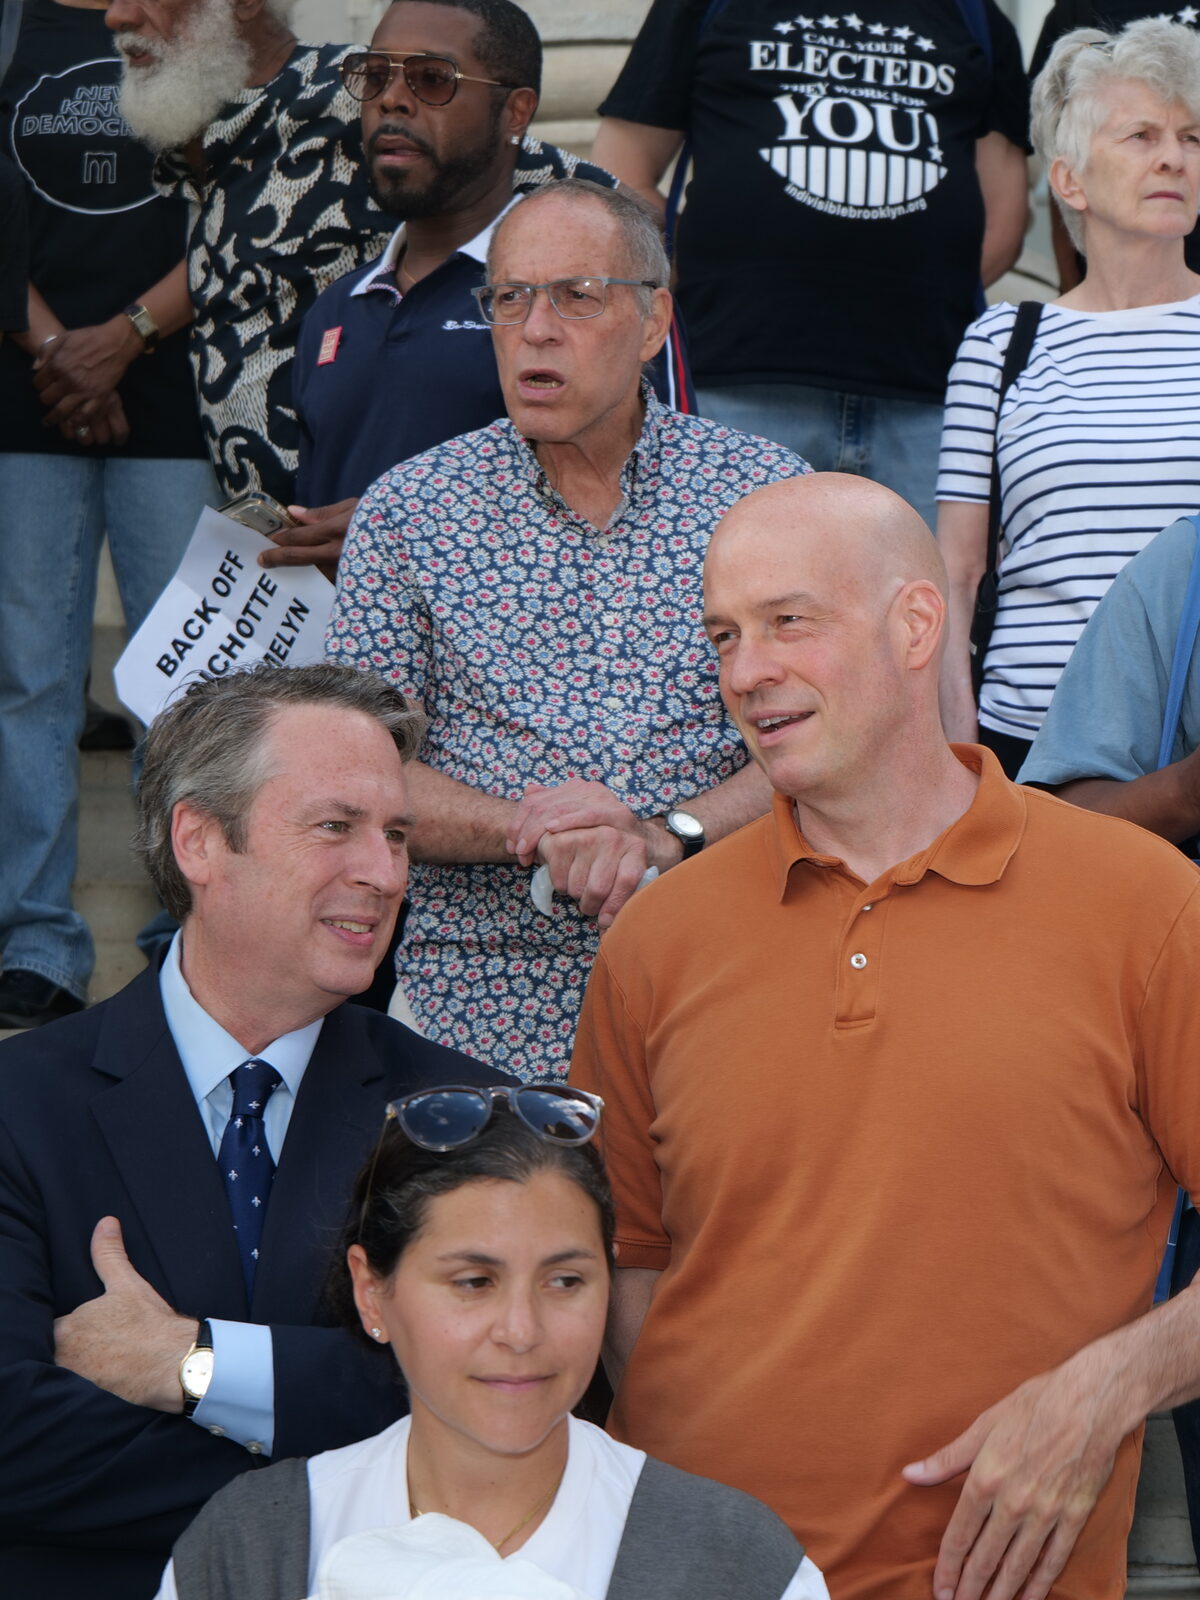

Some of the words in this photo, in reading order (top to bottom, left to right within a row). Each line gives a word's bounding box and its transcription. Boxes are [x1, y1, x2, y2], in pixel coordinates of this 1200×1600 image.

[802, 32, 851, 49] CALL
[854, 40, 906, 55] YOUR
[749, 40, 956, 96] ELECTEDS
[779, 81, 829, 97] THEY
[832, 83, 890, 102] WORK
[892, 91, 928, 107] FOR
[773, 93, 944, 163] YOU!
[784, 182, 928, 220] indivisiblebrooklyn.org
[155, 596, 221, 678] BACK
[211, 549, 245, 599] OFF
